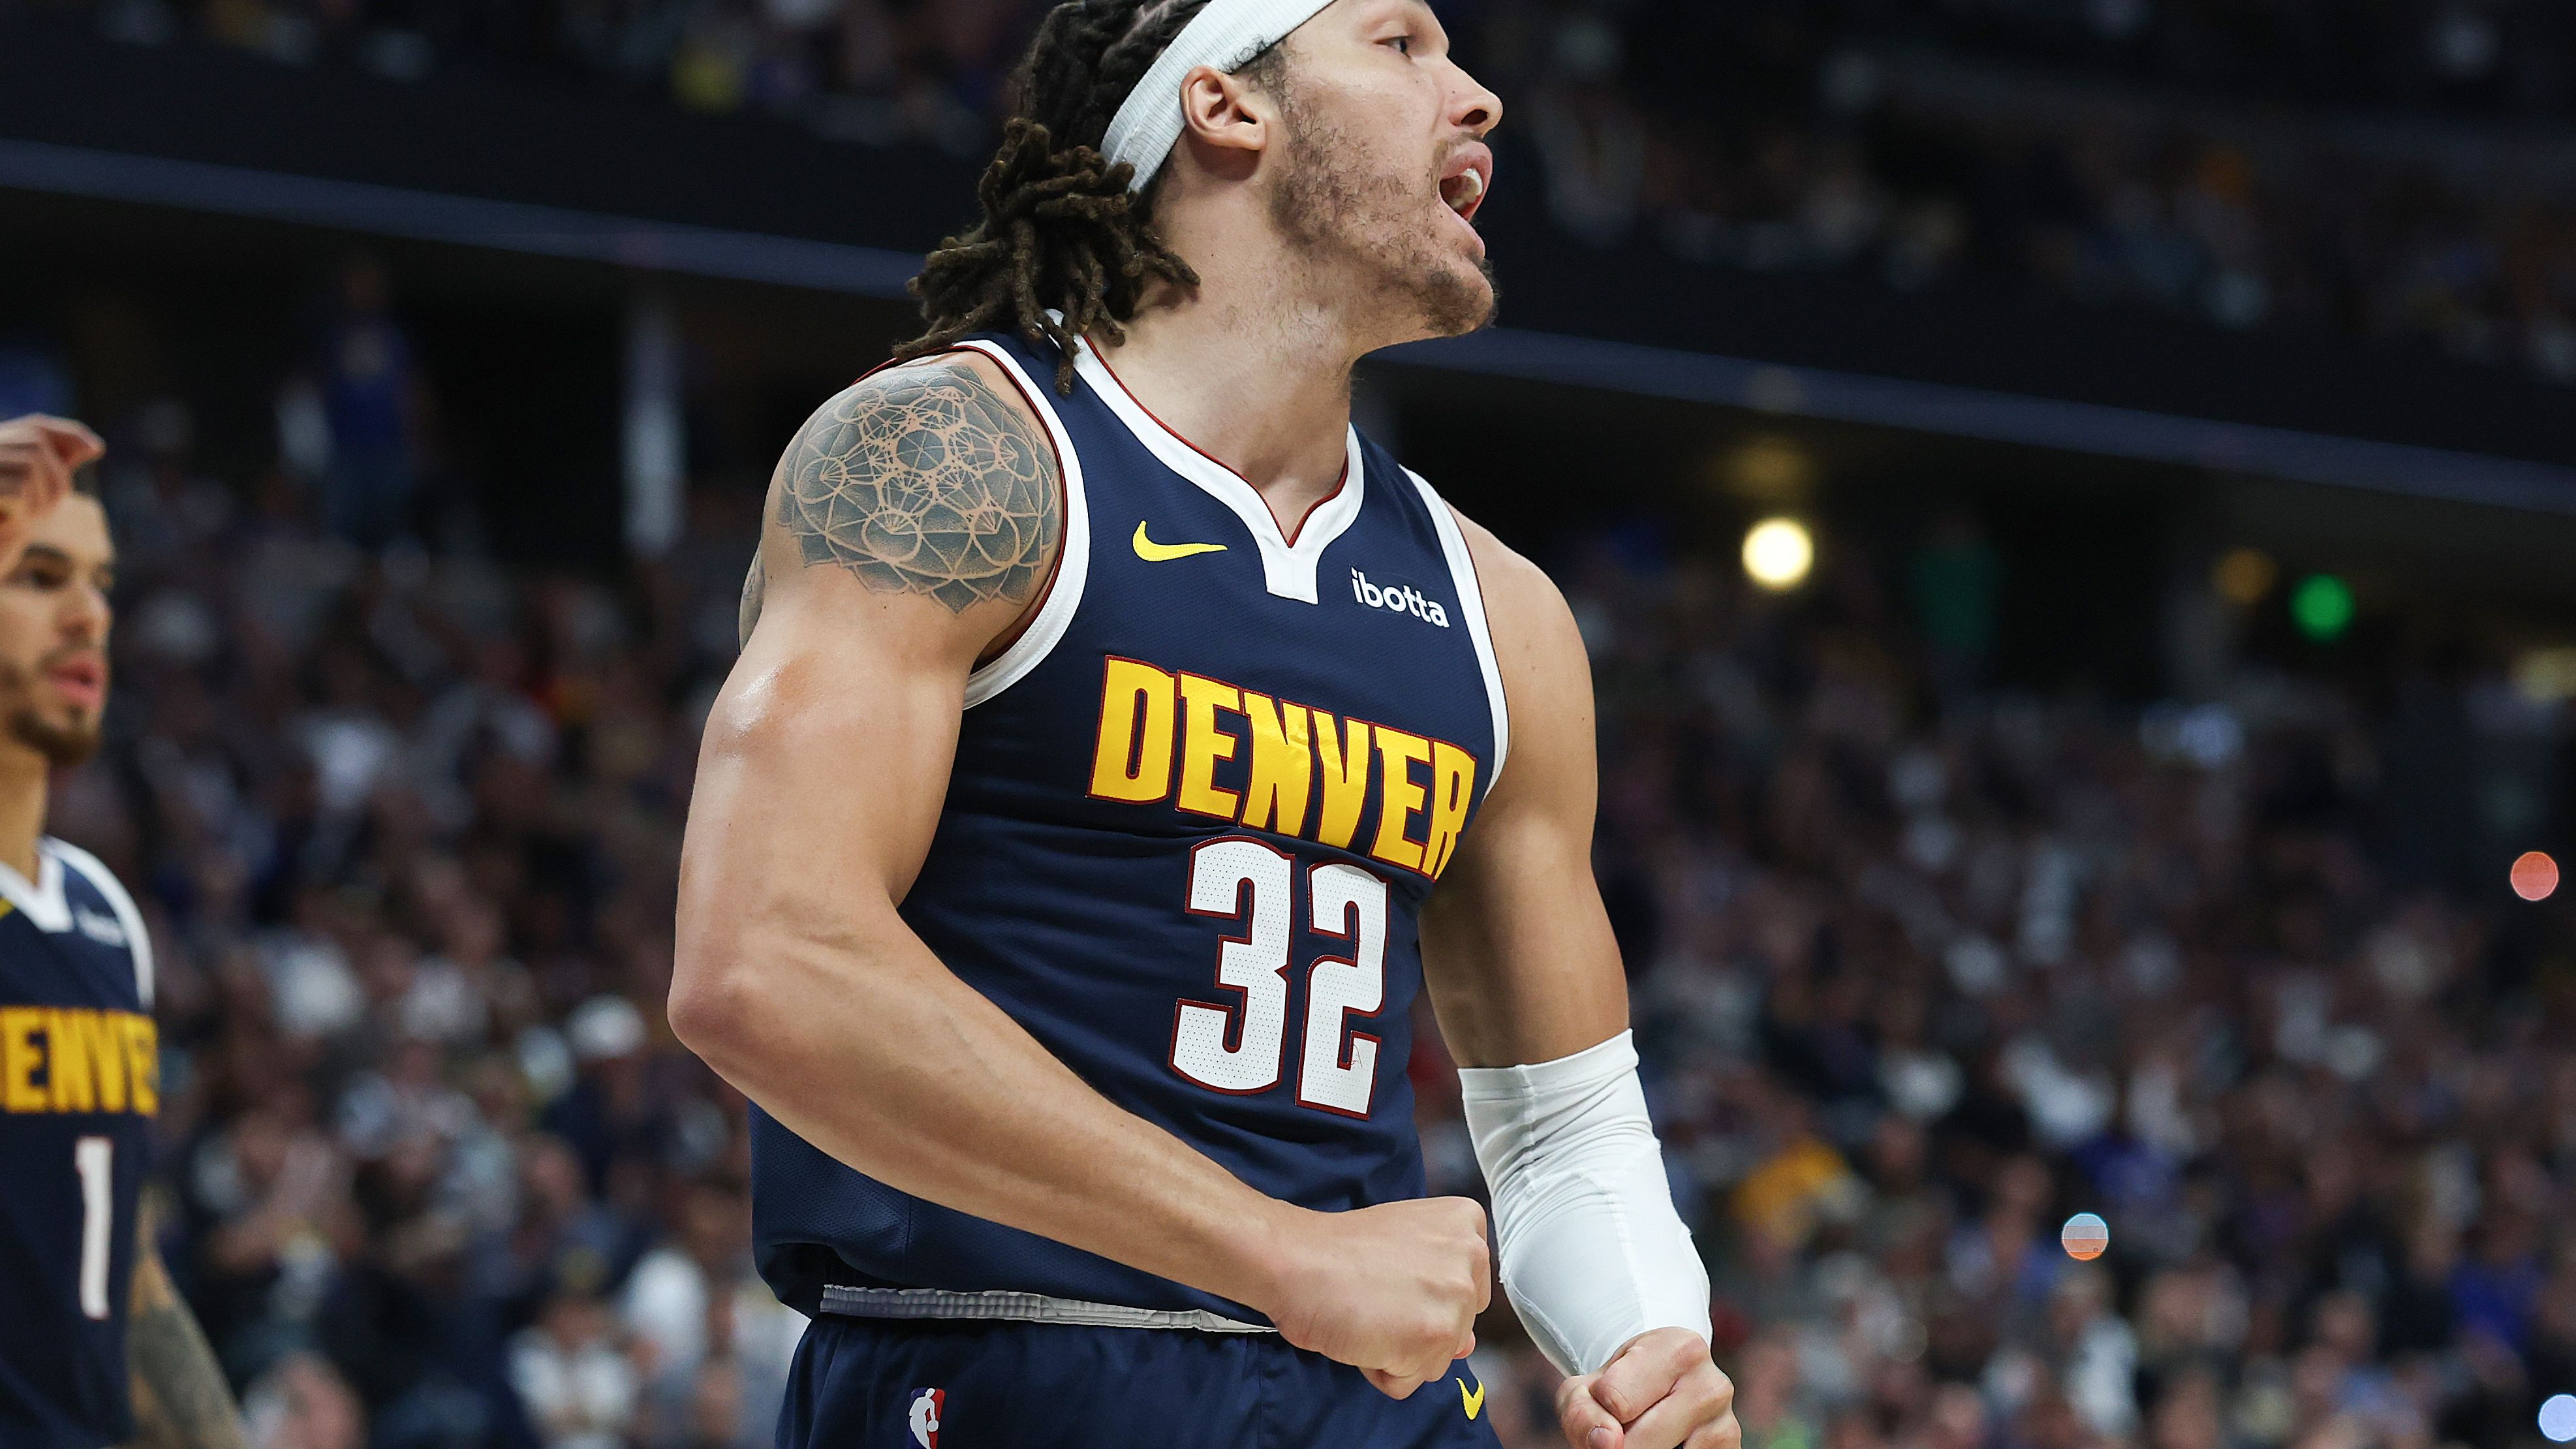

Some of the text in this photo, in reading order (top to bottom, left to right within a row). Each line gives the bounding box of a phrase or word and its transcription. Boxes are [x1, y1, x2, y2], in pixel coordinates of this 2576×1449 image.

[1350, 567, 1450, 628] ibotta
[1086, 655, 1478, 882] DENVER
[0, 1006, 161, 1117] ENVE
[1168, 835, 1391, 1121] 32
[74, 1135, 114, 1320] 1
